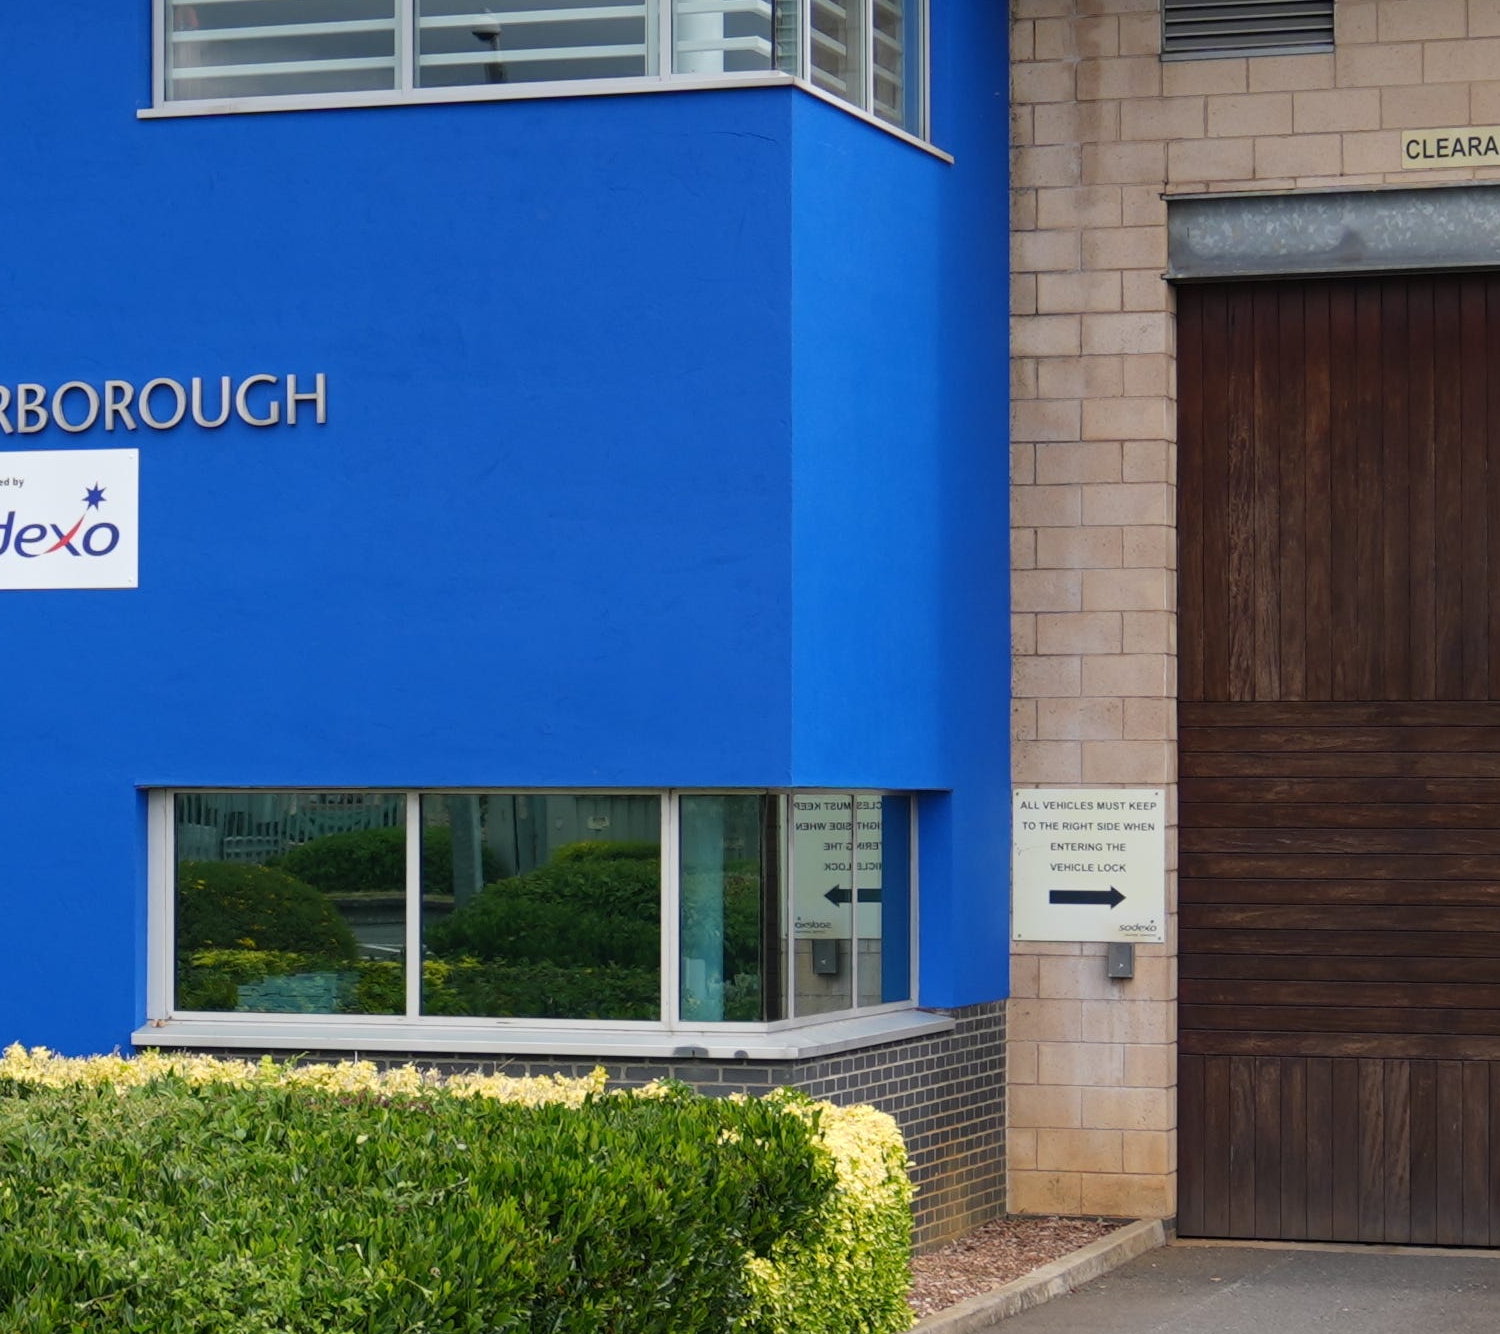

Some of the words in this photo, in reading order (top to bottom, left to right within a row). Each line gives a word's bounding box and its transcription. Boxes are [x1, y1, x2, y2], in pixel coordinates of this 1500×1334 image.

[12, 477, 24, 489] by
[1020, 801, 1040, 810] ALL
[1042, 801, 1094, 810] VEHICLES
[1096, 801, 1126, 811] MUST
[1128, 801, 1157, 811] KEEP
[1022, 821, 1036, 830] TO
[1039, 821, 1059, 830] THE
[1062, 822, 1093, 831] RIGHT
[1096, 822, 1120, 831] SIDE
[1123, 822, 1155, 831] WHEN
[1050, 842, 1103, 851] ENTERING
[1105, 842, 1126, 851] THE
[1050, 862, 1094, 872] VEHICLE
[1097, 863, 1126, 872] LOCK
[1119, 923, 1157, 931] sodexo
